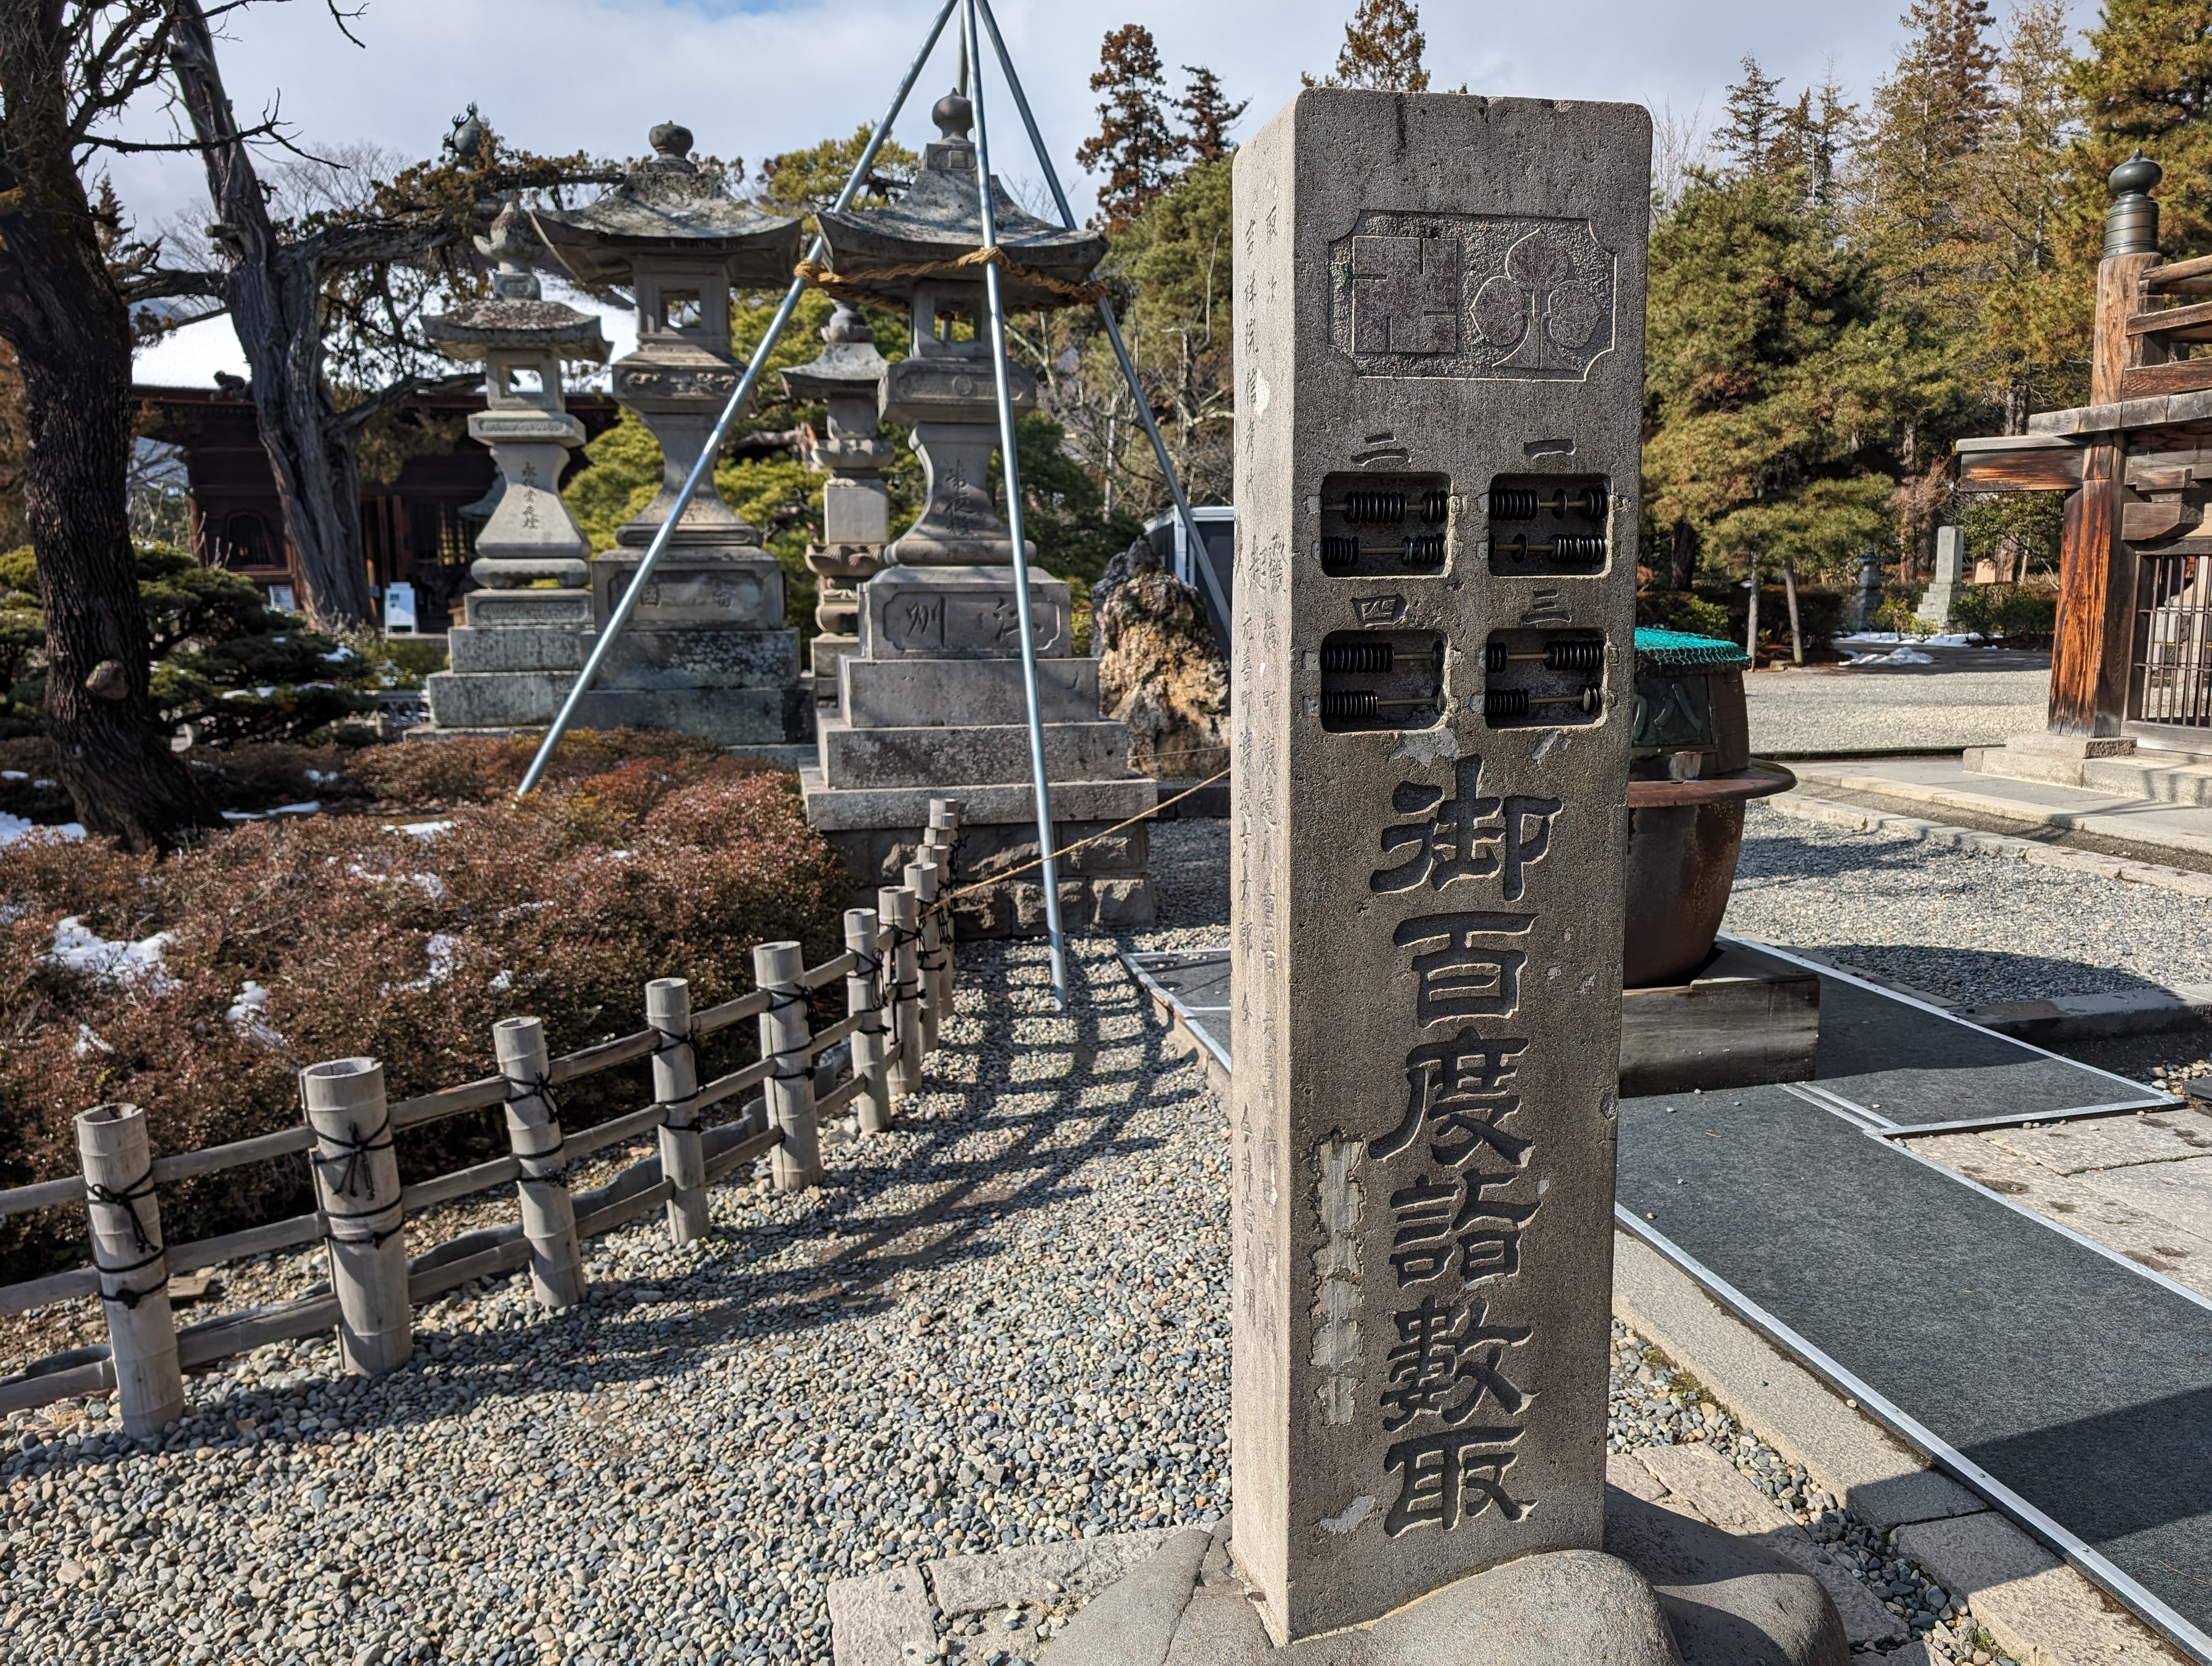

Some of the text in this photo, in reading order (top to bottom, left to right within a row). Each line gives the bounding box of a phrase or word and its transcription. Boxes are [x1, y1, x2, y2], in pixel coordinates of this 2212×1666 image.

[1351, 433, 1411, 466] 二
[1523, 438, 1577, 459] 一
[1351, 593, 1411, 627] 四
[1521, 588, 1572, 625] 三
